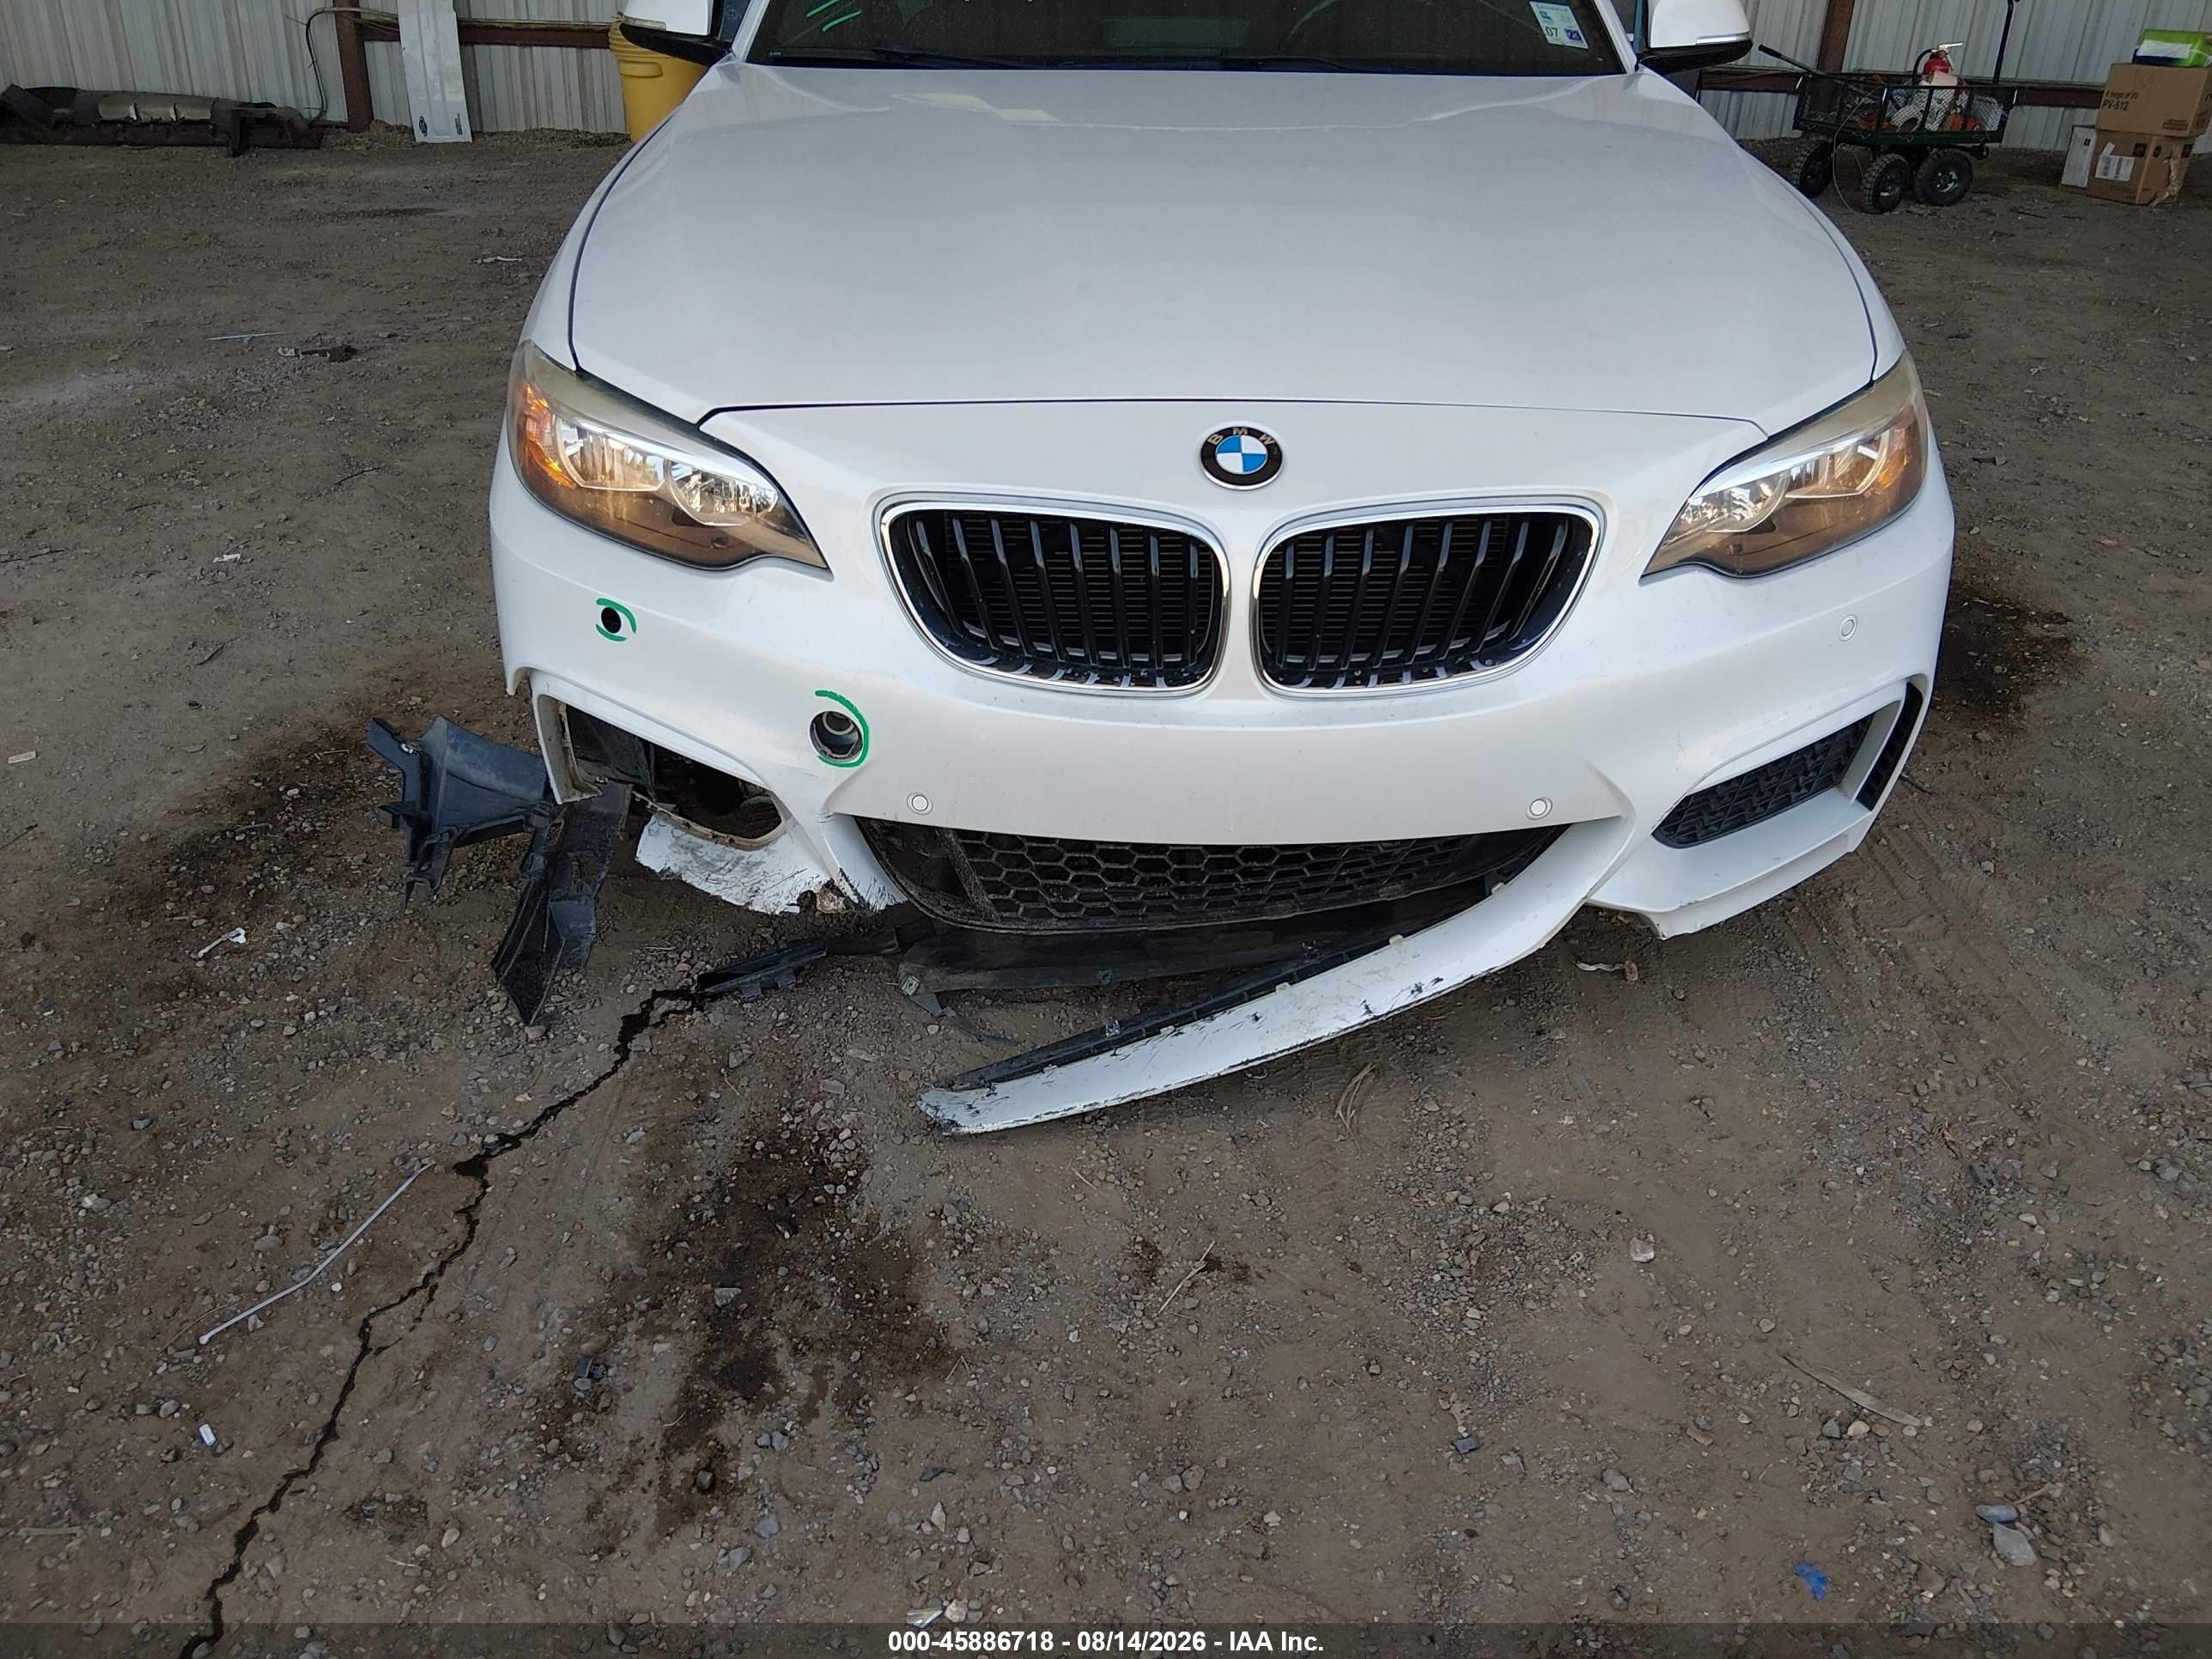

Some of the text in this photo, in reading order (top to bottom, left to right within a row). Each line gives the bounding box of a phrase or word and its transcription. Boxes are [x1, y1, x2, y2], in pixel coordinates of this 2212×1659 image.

[1546, 26, 1582, 41] 07 23
[1206, 427, 1276, 446] BMW
